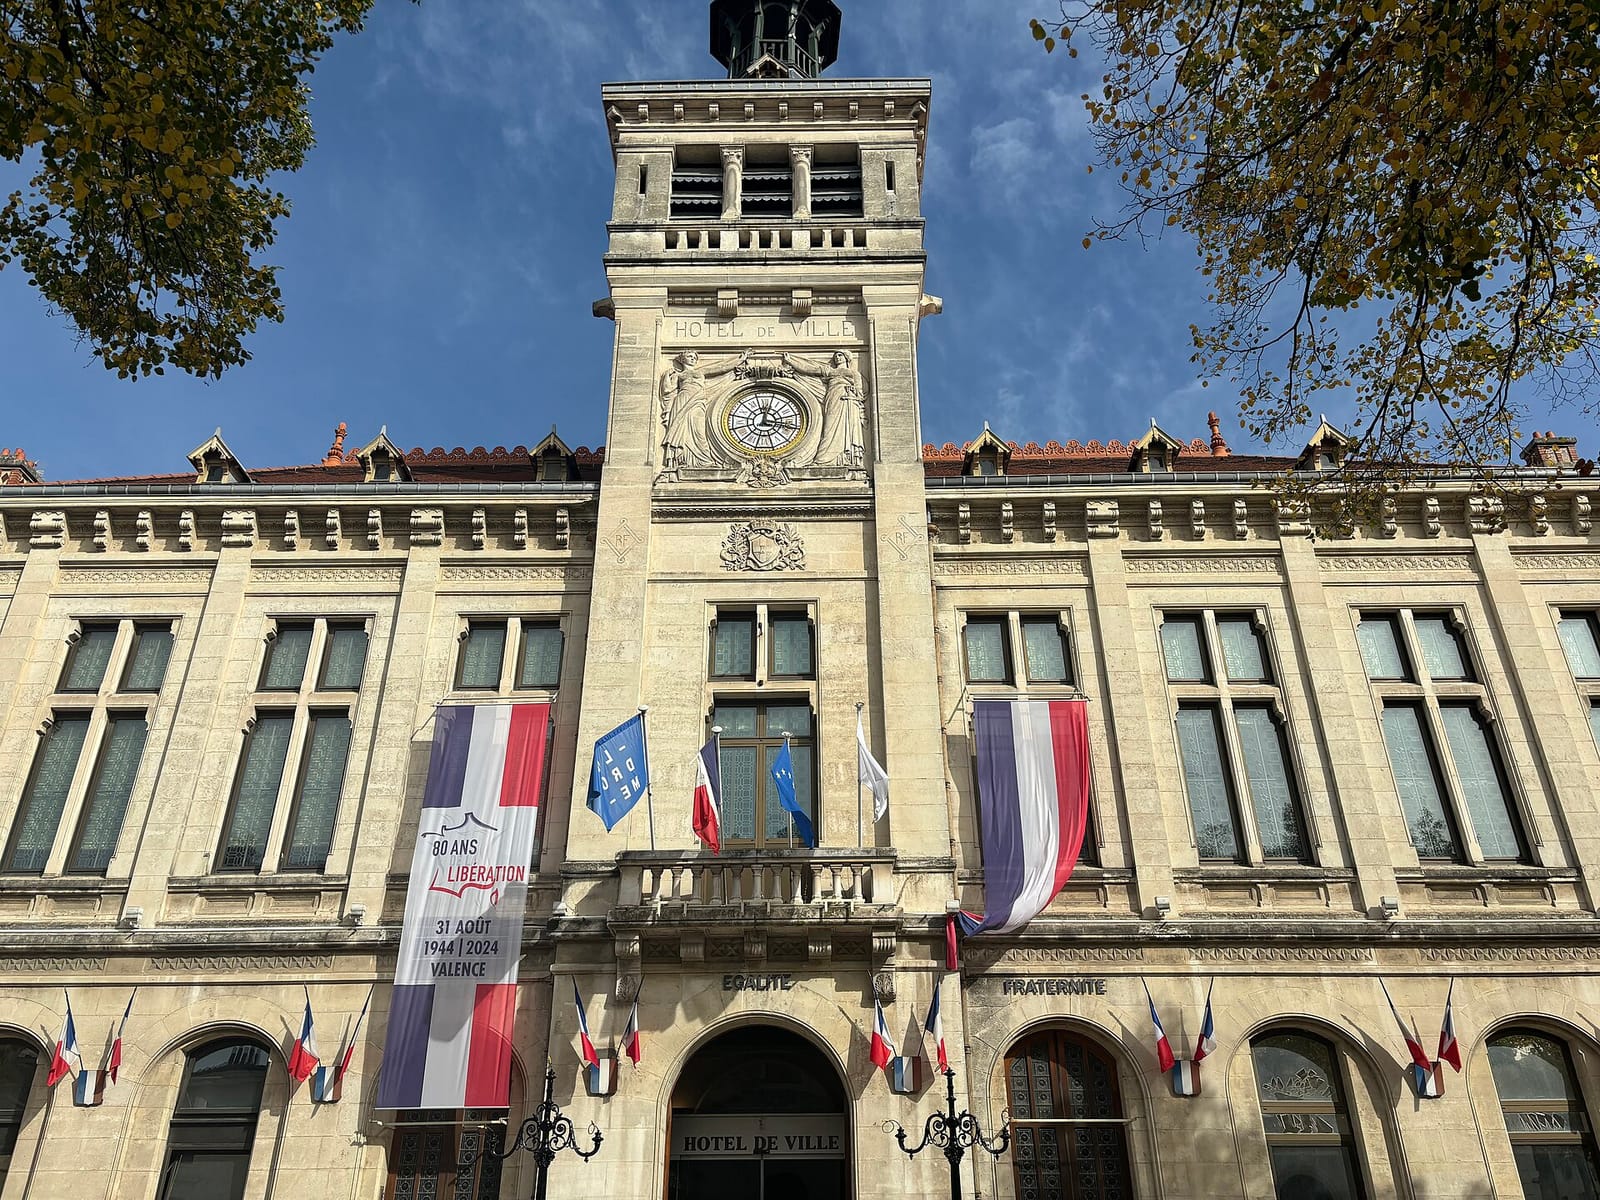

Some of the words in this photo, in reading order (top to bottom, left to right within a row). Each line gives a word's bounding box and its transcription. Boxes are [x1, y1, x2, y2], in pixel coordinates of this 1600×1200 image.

[757, 326, 776, 338] DE
[790, 320, 854, 338] VILLE
[615, 534, 630, 547] RF
[895, 531, 909, 545] RF
[432, 840, 448, 856] 80
[450, 839, 478, 856] ANS
[447, 862, 526, 882] LIBÉRATION
[435, 920, 450, 935] 31
[455, 915, 492, 935] AOÛT
[424, 940, 455, 956] 1944
[466, 940, 499, 955] 2024
[431, 962, 486, 977] VALENCE
[683, 1136, 748, 1151] HOTEL
[753, 1135, 778, 1151] DE
[784, 1135, 840, 1150] VILLE
